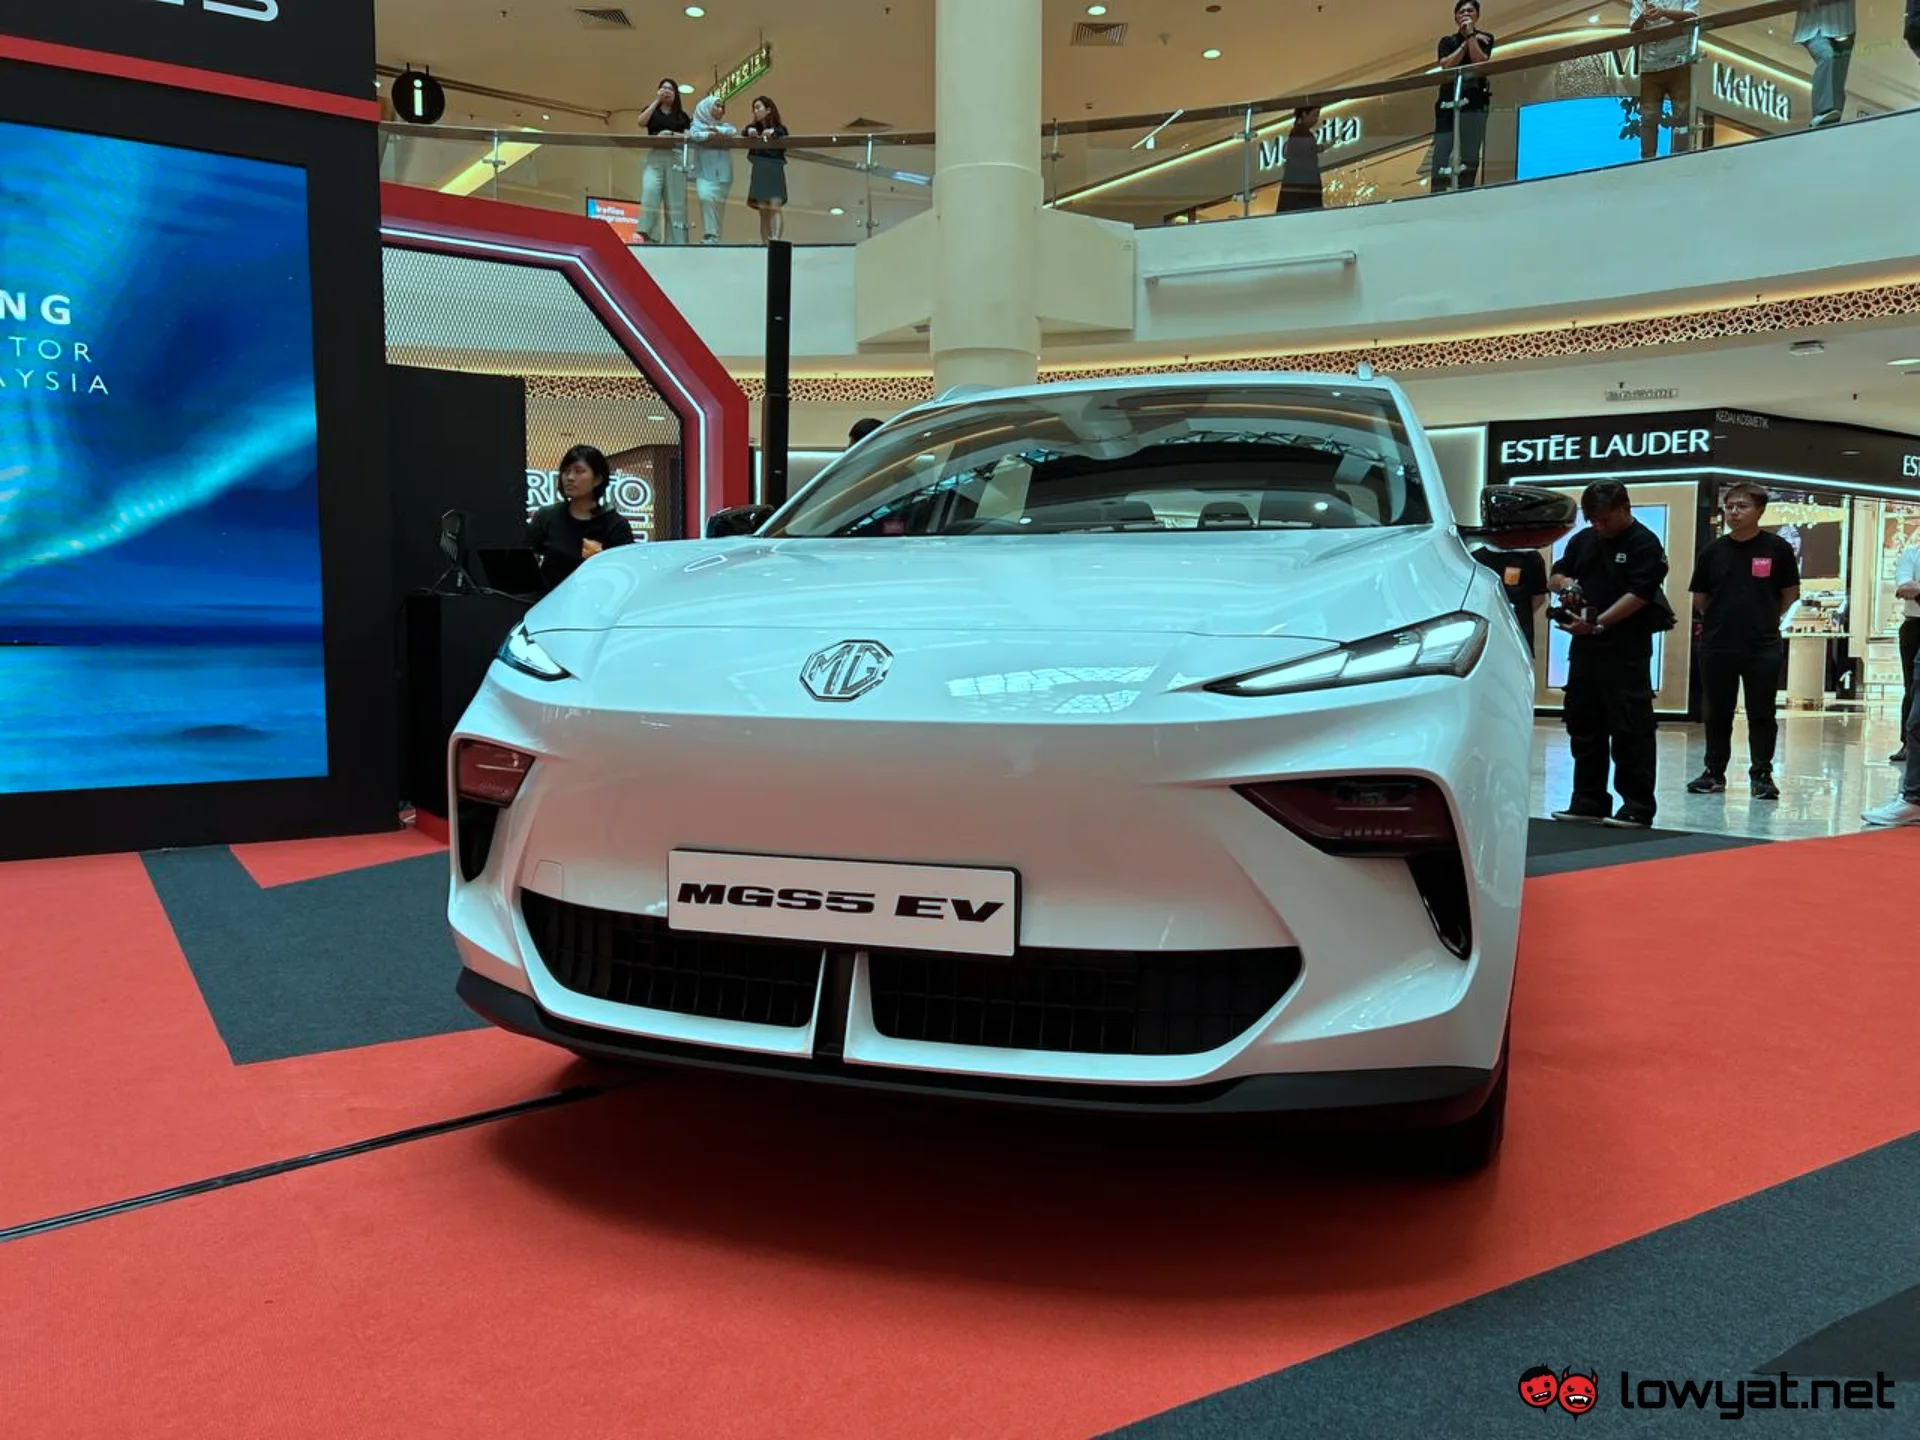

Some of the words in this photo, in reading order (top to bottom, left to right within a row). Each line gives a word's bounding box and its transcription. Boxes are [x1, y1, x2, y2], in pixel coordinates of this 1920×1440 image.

[1712, 62, 1791, 122] Melvita
[1590, 429, 1709, 459] LAUDER
[1903, 455, 1920, 477] ES
[805, 643, 886, 696] MG
[677, 883, 875, 914] MGS5
[895, 895, 1004, 923] EV
